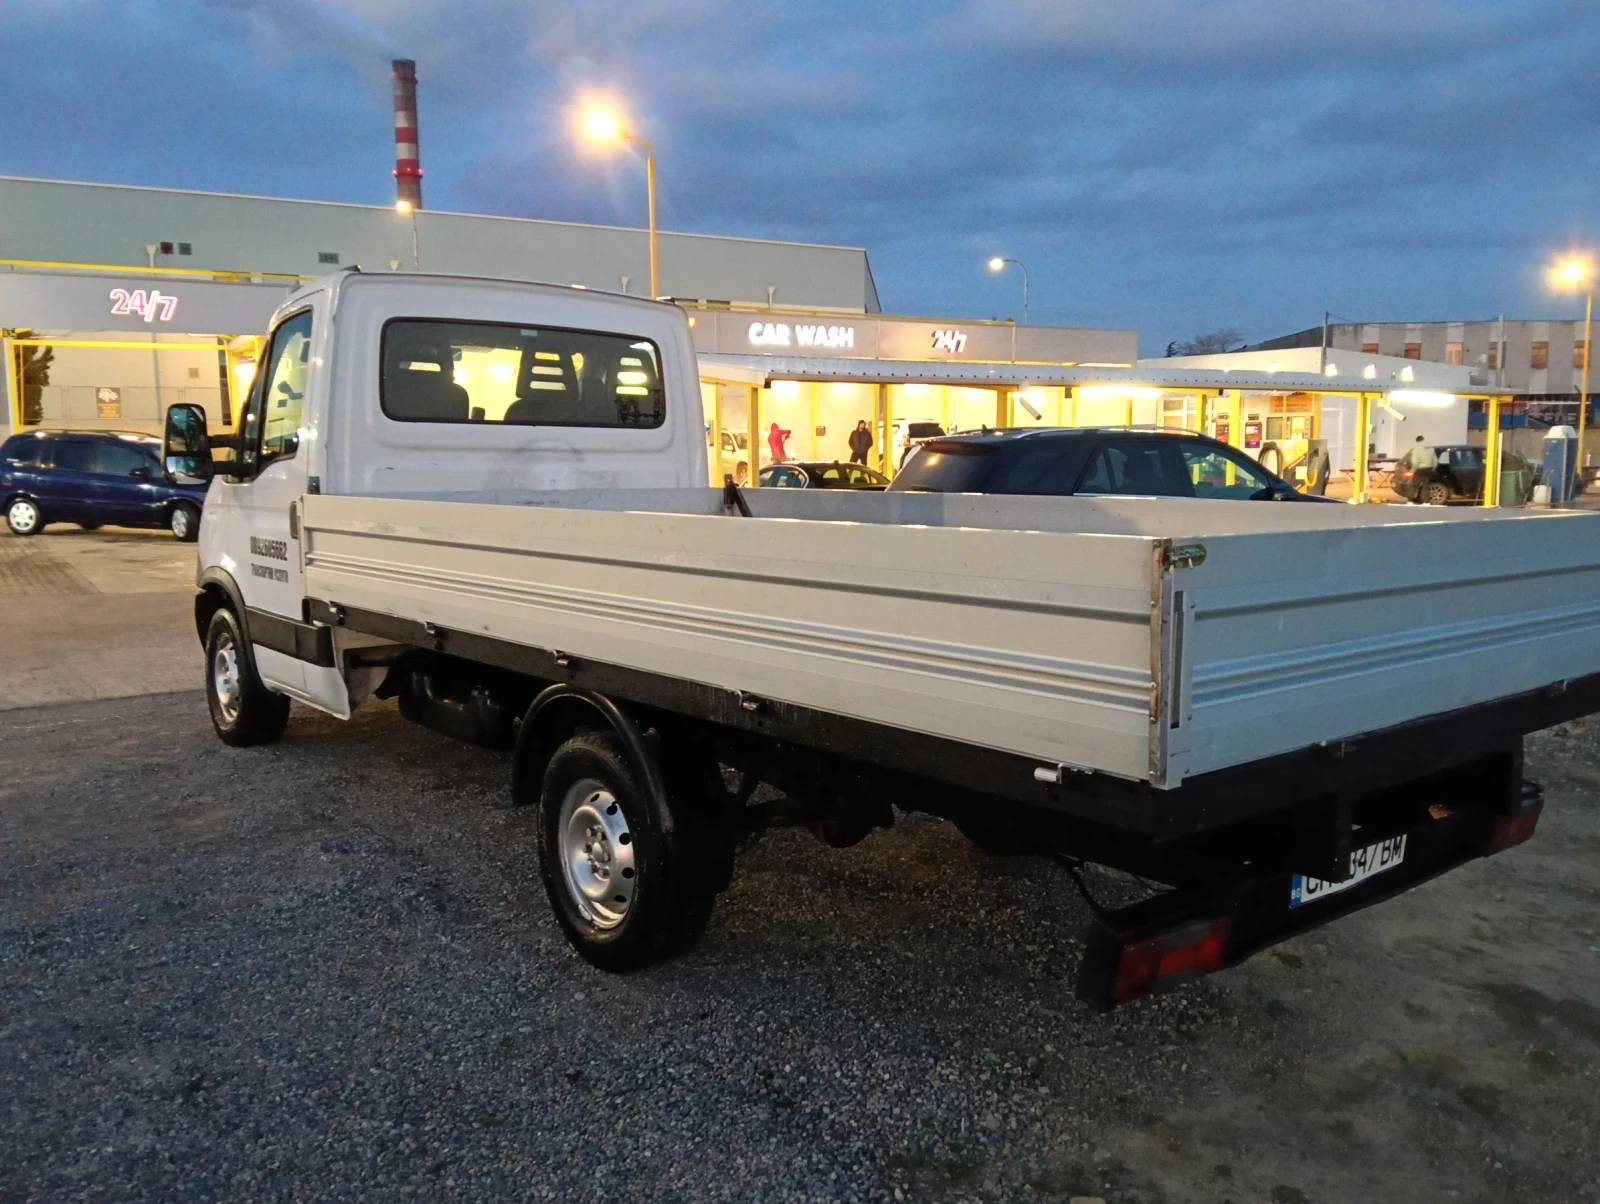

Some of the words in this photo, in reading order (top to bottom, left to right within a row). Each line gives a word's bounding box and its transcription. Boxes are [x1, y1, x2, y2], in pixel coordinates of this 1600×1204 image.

[109, 288, 178, 323] 24/7
[748, 322, 790, 346] CAR
[795, 324, 854, 348] WASH
[932, 329, 968, 354] 24/7
